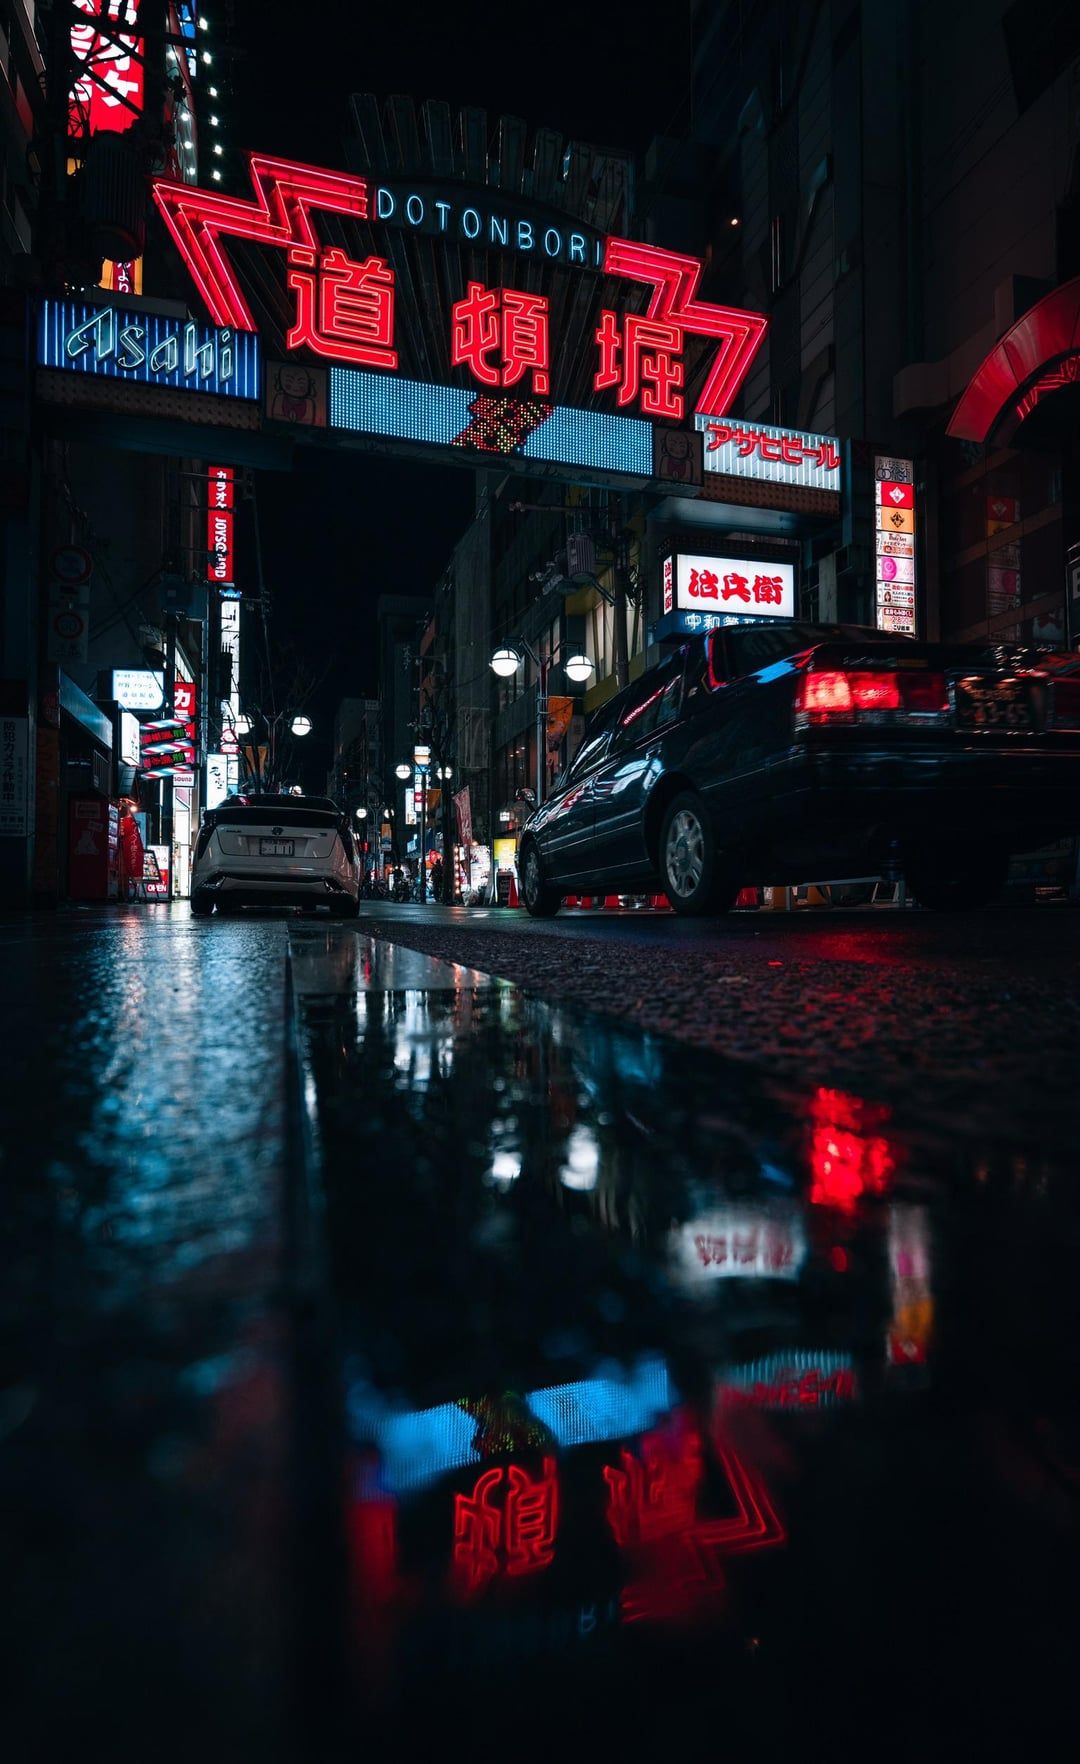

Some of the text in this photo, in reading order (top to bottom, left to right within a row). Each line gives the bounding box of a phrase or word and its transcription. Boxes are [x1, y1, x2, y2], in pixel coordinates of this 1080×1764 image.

[377, 189, 600, 265] DOTONBORI
[66, 304, 233, 382] Asahi
[287, 247, 684, 420] 道頓堀
[706, 423, 841, 469] アサヒビール
[215, 471, 226, 509] カラオケ
[688, 568, 783, 605] 治兵衛
[3, 720, 16, 802] 防犯カメラ作動中
